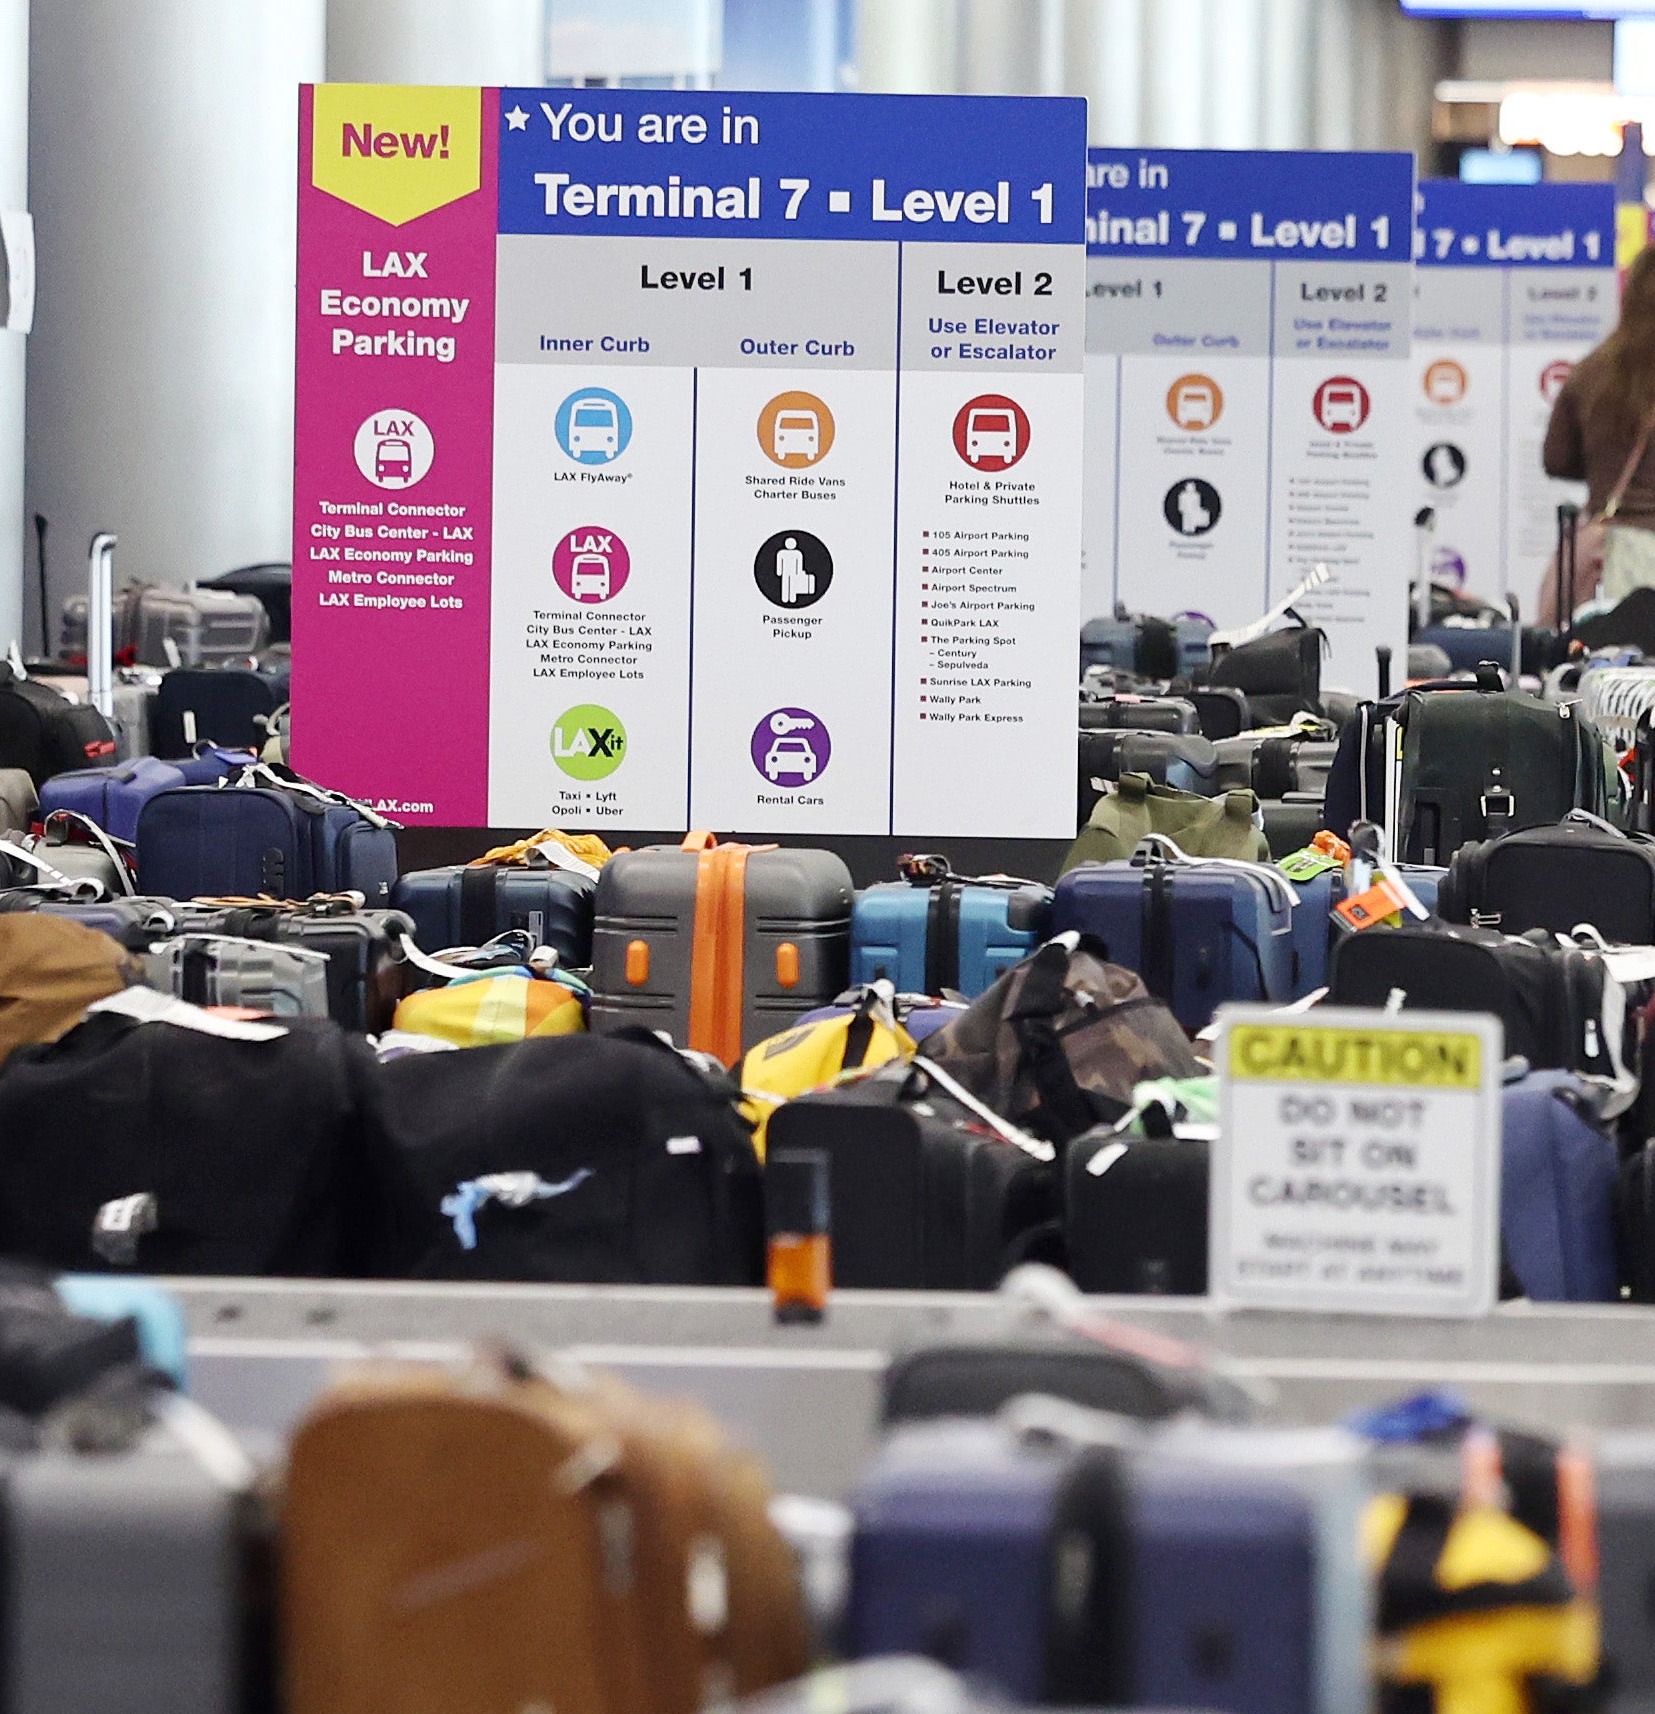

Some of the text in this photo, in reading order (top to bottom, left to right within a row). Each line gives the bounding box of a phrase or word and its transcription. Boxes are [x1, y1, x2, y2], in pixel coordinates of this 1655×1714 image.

[540, 102, 759, 144] You are in
[342, 122, 449, 159] New!
[1138, 158, 1170, 189] in
[534, 173, 1053, 224] Terminal 7 Level 1
[1181, 210, 1390, 249] 7 Level 1
[1431, 228, 1601, 261] 7 Level 1
[362, 251, 428, 278] LAX
[641, 265, 752, 291] Level 1
[938, 270, 1053, 296] Level 2
[1153, 280, 1163, 298] 1
[1301, 282, 1387, 302] Level 2
[320, 289, 469, 324] Economy
[928, 318, 1060, 335] Use Elevator
[332, 328, 455, 362] Parking
[540, 335, 650, 352] Inner Curb
[740, 338, 855, 356] Outer Curb
[930, 343, 1057, 360] or Escalator
[373, 419, 415, 437] LAX
[554, 472, 576, 482] LAX
[745, 475, 846, 487] Shared Ride Vans
[949, 481, 1036, 491] Hotel & Private
[754, 490, 837, 500] Charter Buses
[945, 494, 1040, 506] Parking Shuttles
[319, 501, 466, 517] Terminal Connector
[310, 524, 473, 540] City Bus Center LAX
[933, 531, 1029, 542] 105 Airport Parking
[570, 535, 613, 553] LAX
[310, 547, 474, 565] LAX Economy Parking
[932, 549, 1029, 559] 405 Airport Parking
[328, 570, 455, 585] Metro Connector
[931, 566, 1003, 576] Airport Center
[931, 583, 1017, 594] Airport Spectrum
[319, 593, 463, 610] LAX Employee Lots
[931, 601, 1035, 612] Joe's Airport Parking
[533, 610, 646, 622] Terminal Connector
[762, 614, 823, 626] Passenger
[931, 618, 999, 628] QuikPark LAX
[526, 625, 652, 636] City Bus Center LAX
[772, 629, 812, 640] Pickup
[526, 639, 652, 652] LAX Economy Parking
[931, 636, 1017, 646] The Parking Spot
[540, 654, 638, 665] Metro Connector
[937, 649, 977, 659] Century
[937, 660, 989, 670] Sepulveda
[533, 668, 644, 680] LAX Employee Lots
[930, 678, 1032, 688] Sunrise LAX Parking
[930, 696, 982, 705] Wally Park
[930, 713, 1024, 723] Wally Park Express
[554, 726, 624, 758] LAXit
[559, 791, 617, 802] Taxi Lyft
[757, 795, 824, 805] Rental Cars
[551, 806, 624, 816] Opoli Uber
[1241, 1032, 1471, 1081] CAUTION
[1278, 1095, 1424, 1127] DO NOT
[1291, 1138, 1416, 1169] SIT ON
[1248, 1174, 1455, 1216] CAROUSEL
